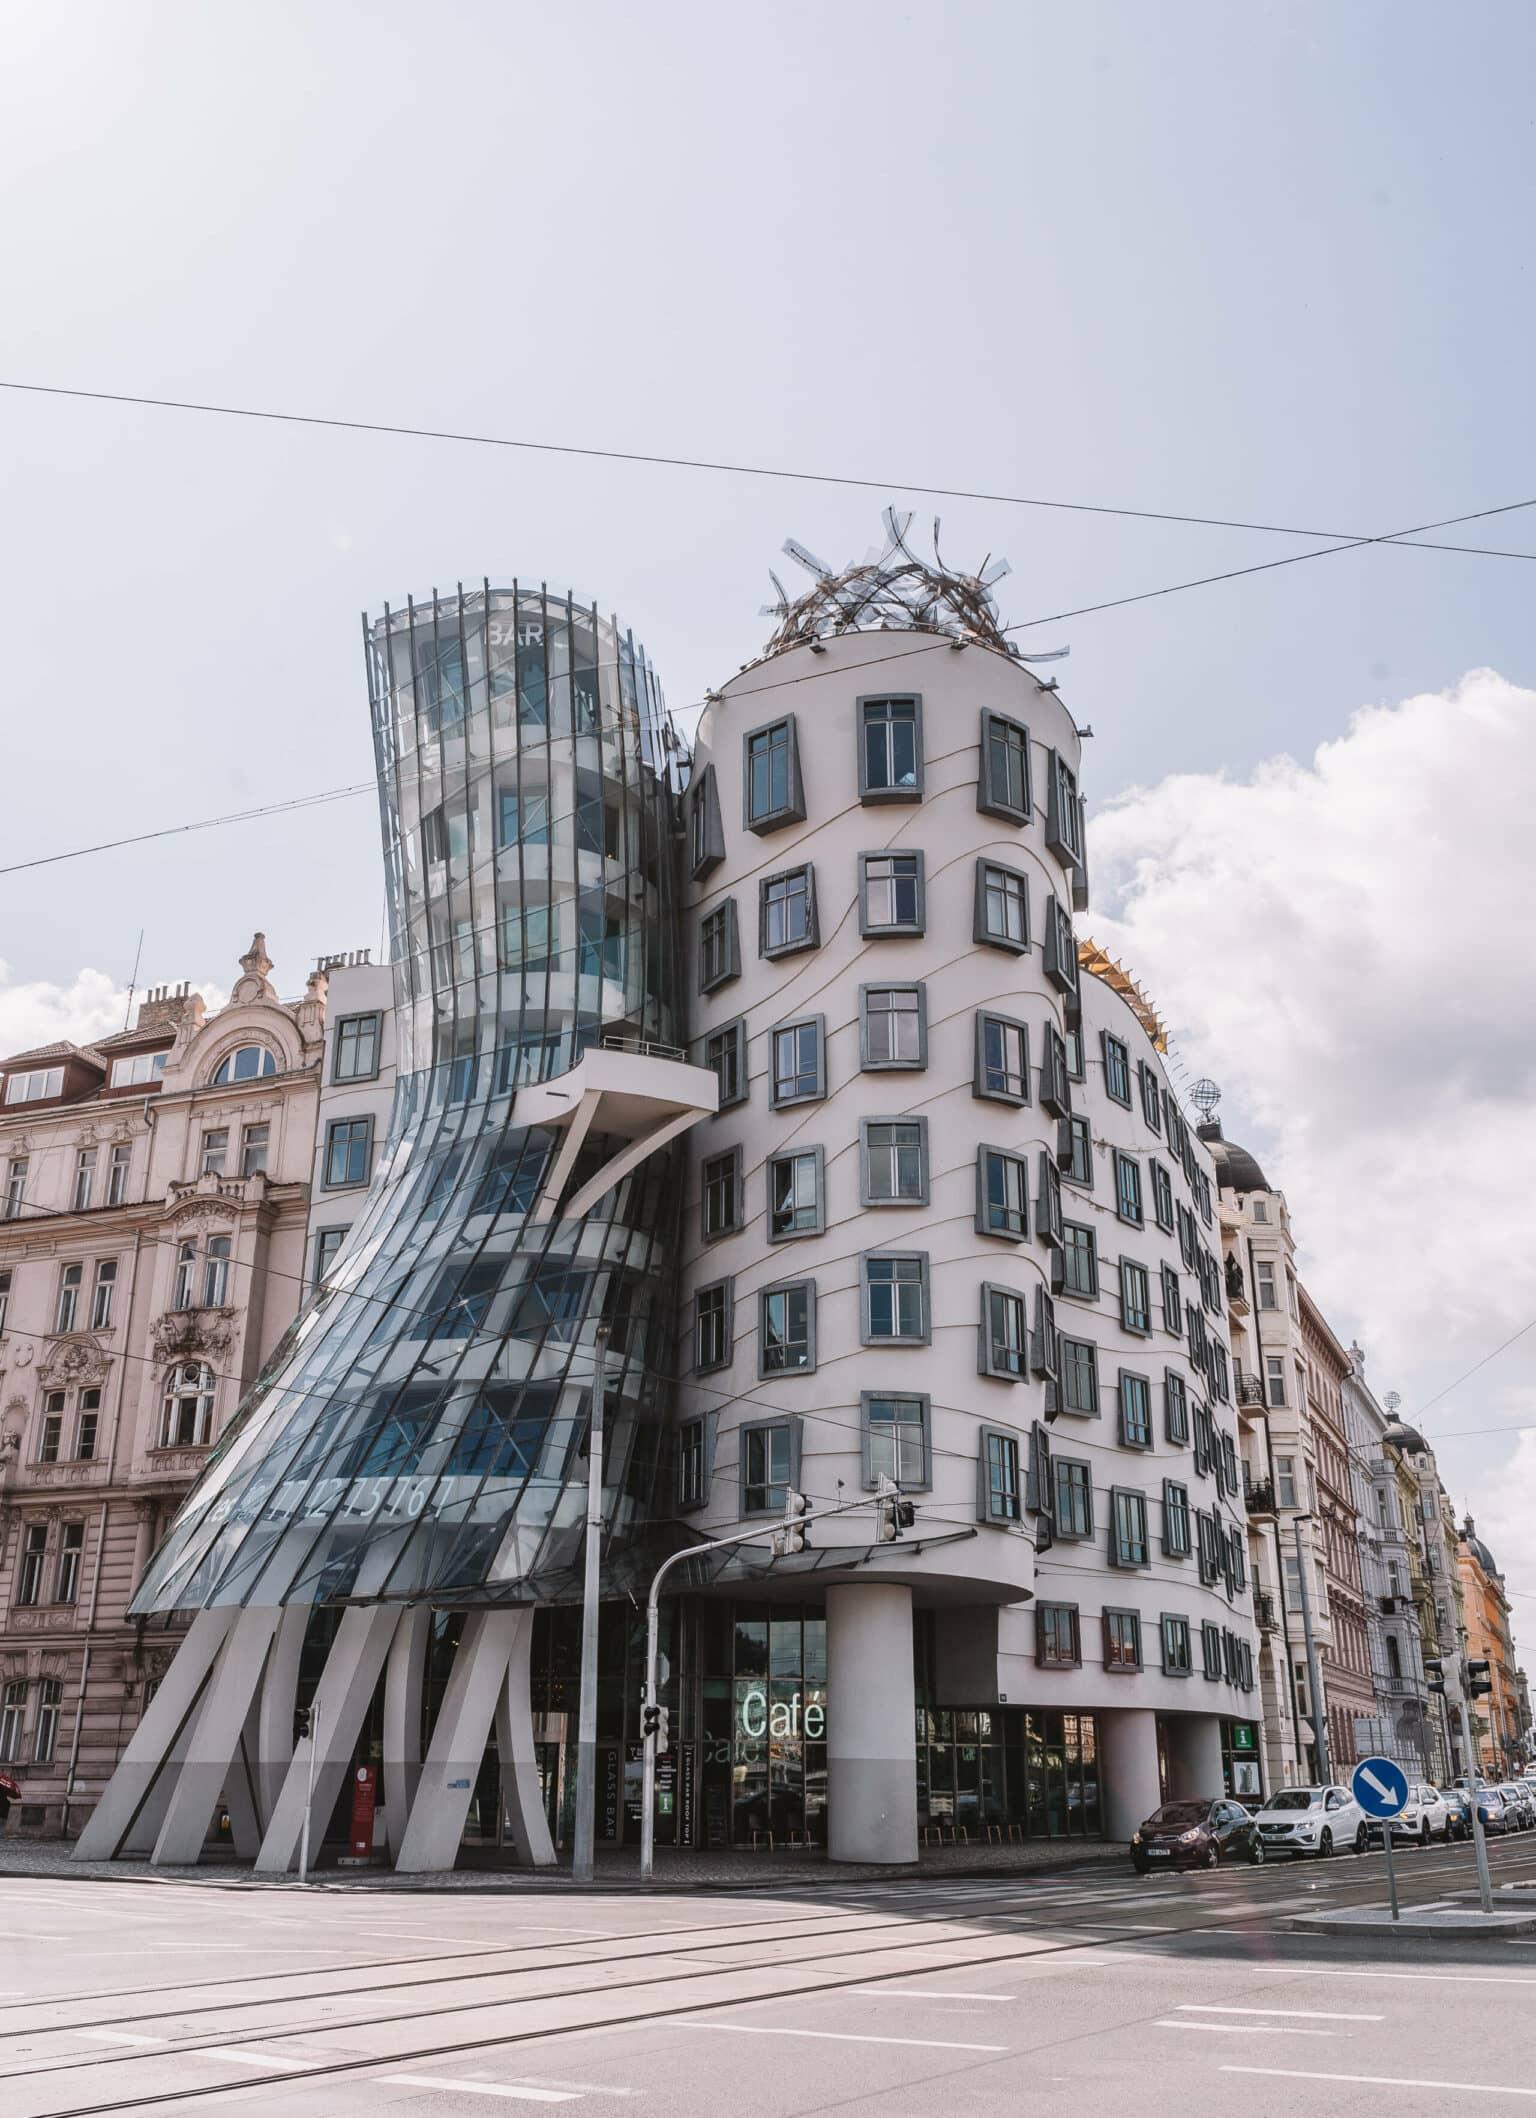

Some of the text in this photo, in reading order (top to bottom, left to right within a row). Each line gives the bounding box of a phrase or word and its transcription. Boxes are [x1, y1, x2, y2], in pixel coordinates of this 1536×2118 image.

[484, 622, 545, 646] BAR
[743, 1690, 825, 1738] Café
[606, 1752, 617, 1837] GLASS BAR
